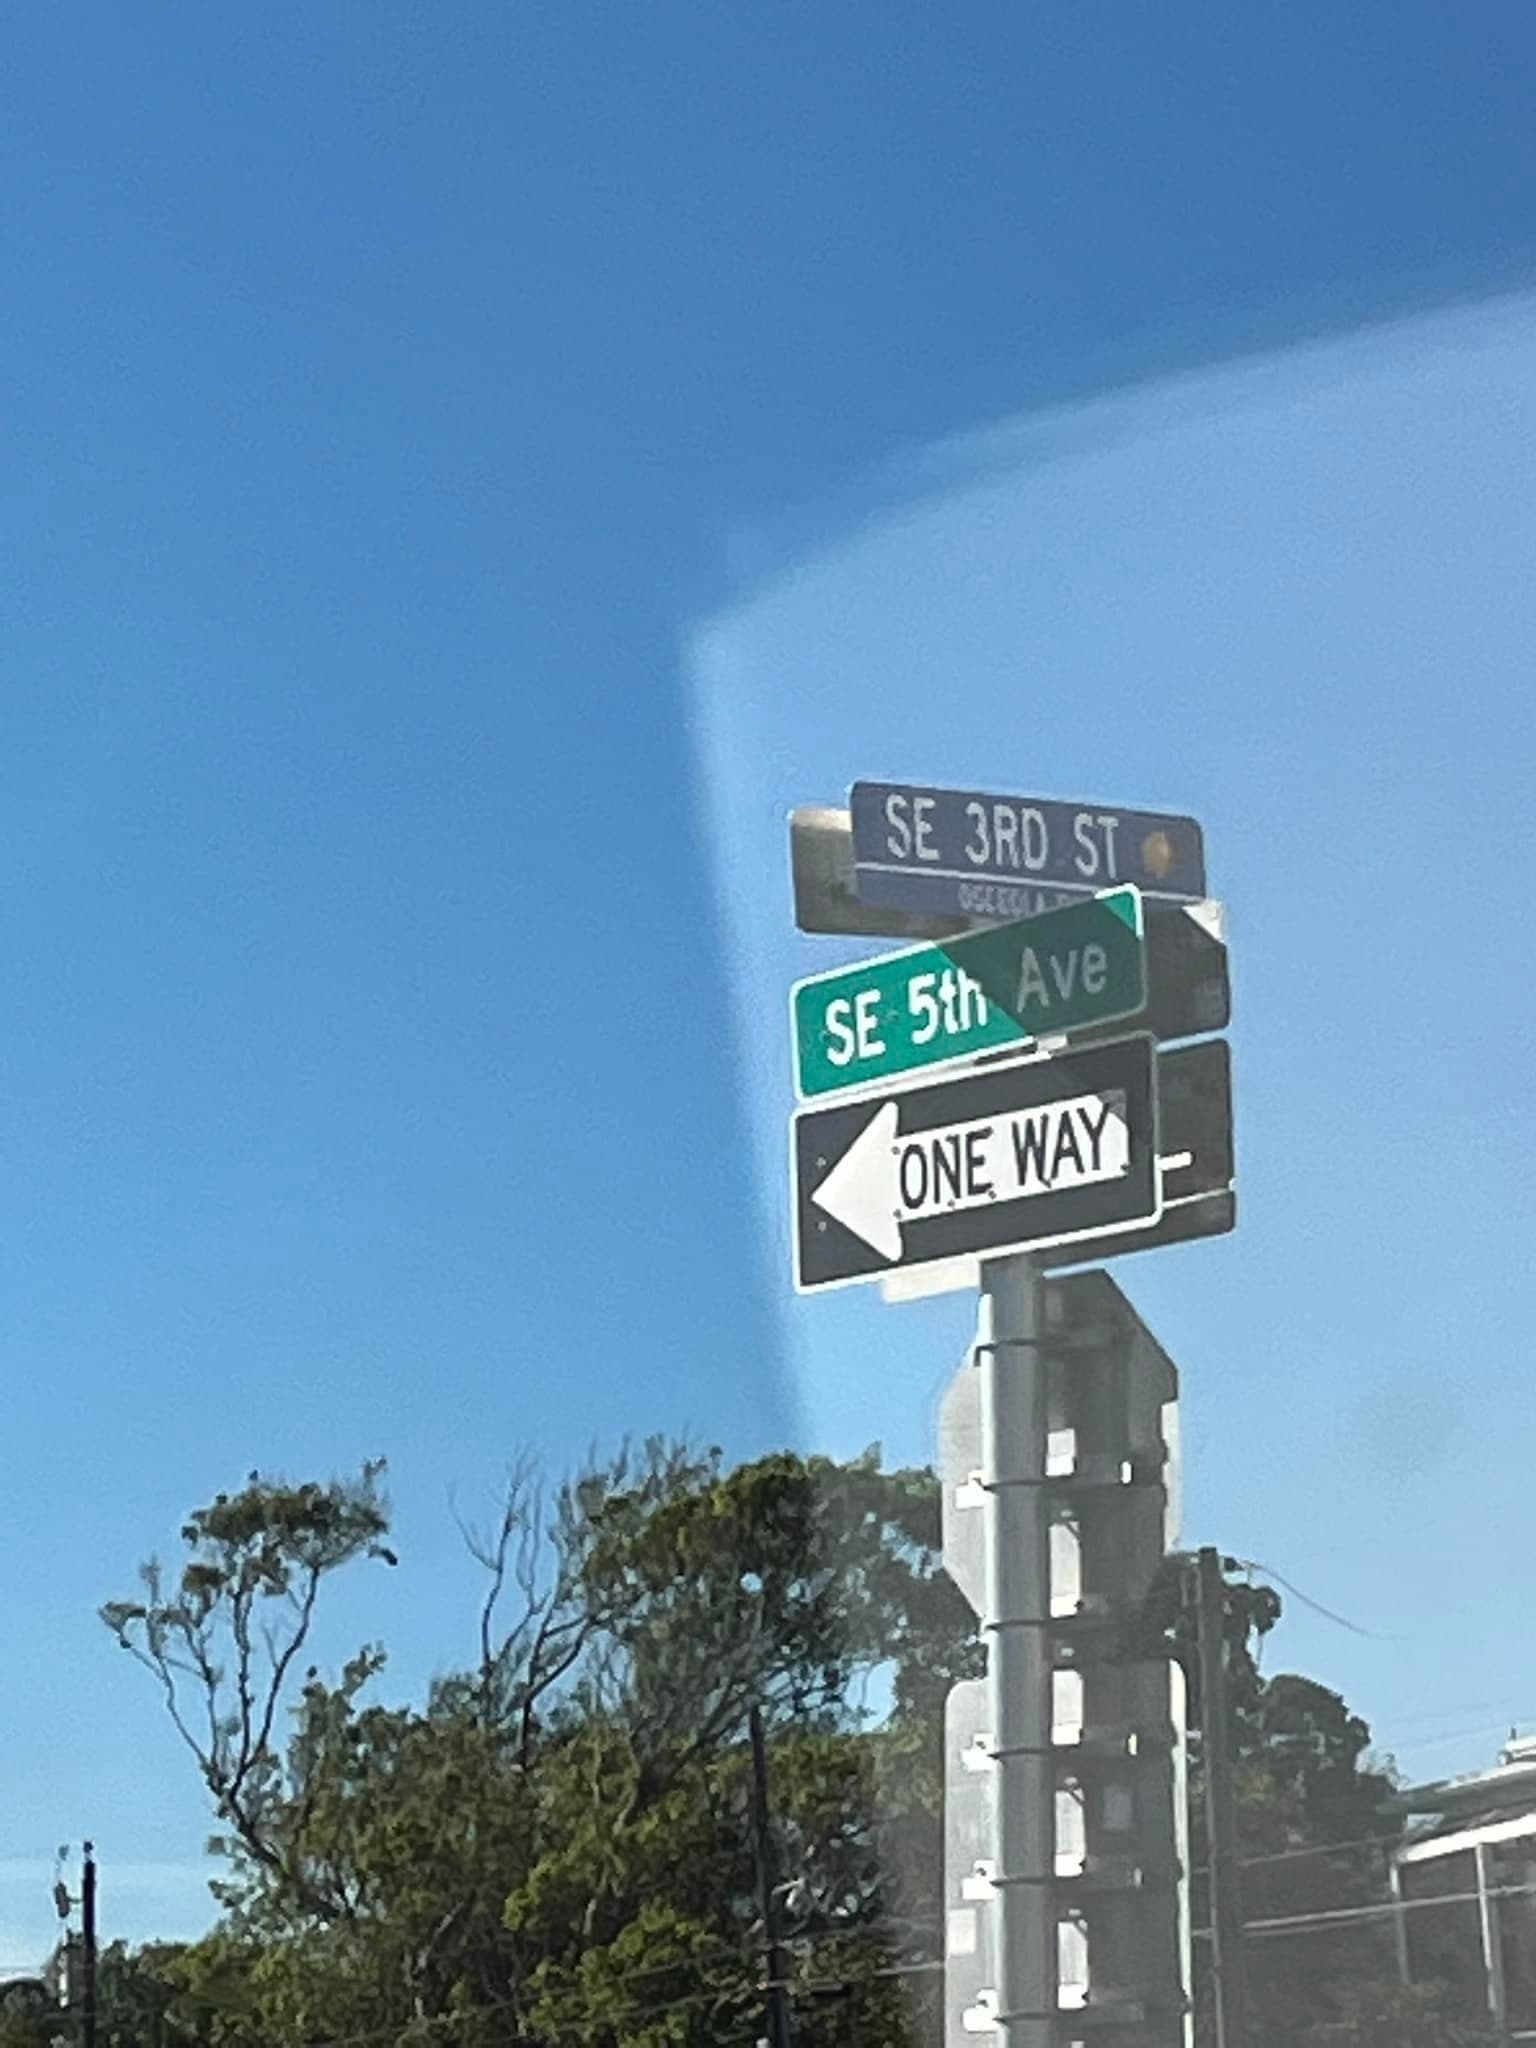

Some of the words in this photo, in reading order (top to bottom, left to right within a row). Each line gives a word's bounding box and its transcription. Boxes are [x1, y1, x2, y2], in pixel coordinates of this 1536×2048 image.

[885, 794, 939, 861] SE
[964, 801, 1049, 870] 3RD
[1073, 812, 1119, 880] ST
[825, 989, 886, 1067] SE
[907, 967, 988, 1044] 5th
[1016, 944, 1108, 1015] Ave
[900, 1126, 994, 1210] ONE
[1011, 1101, 1112, 1187] WAY
